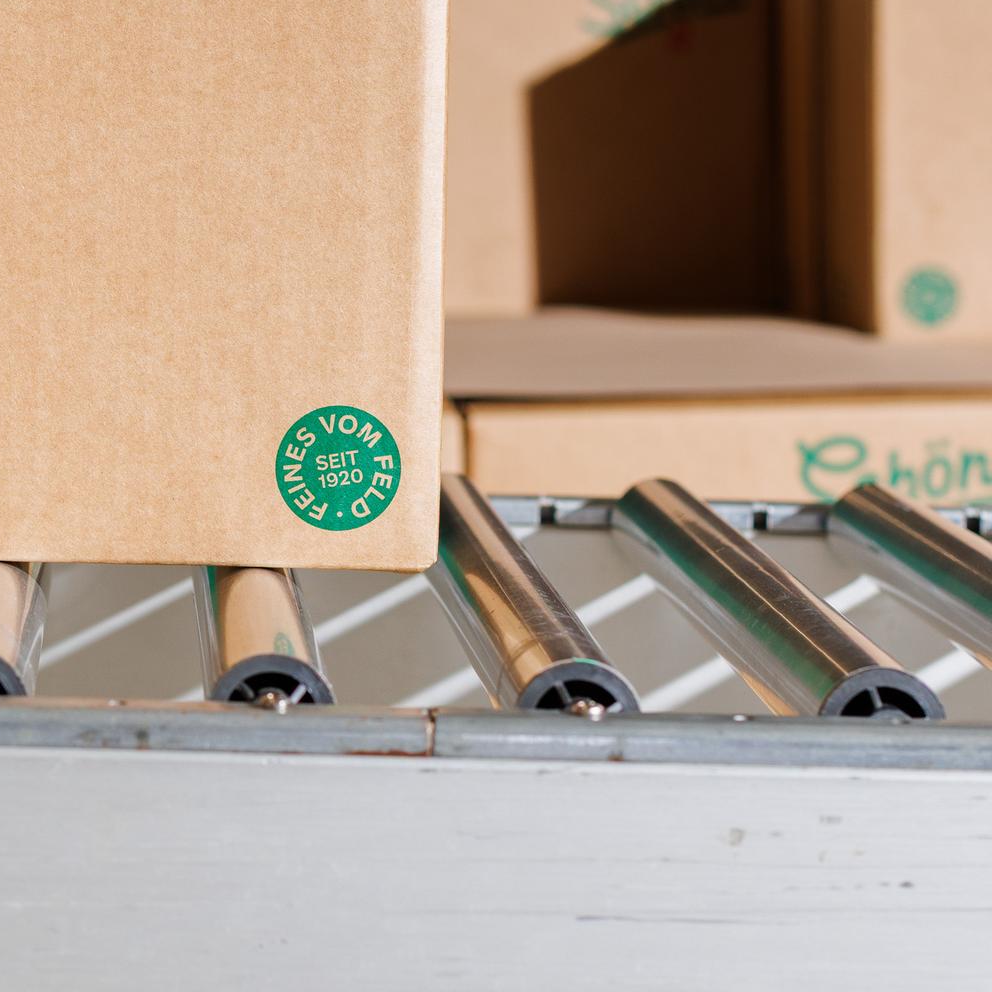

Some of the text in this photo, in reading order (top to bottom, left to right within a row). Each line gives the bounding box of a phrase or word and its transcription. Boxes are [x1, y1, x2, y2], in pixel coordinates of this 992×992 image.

[282, 413, 394, 521] FEINES VOM FELD
[315, 449, 359, 471] SEIT
[318, 468, 364, 489] 1920
